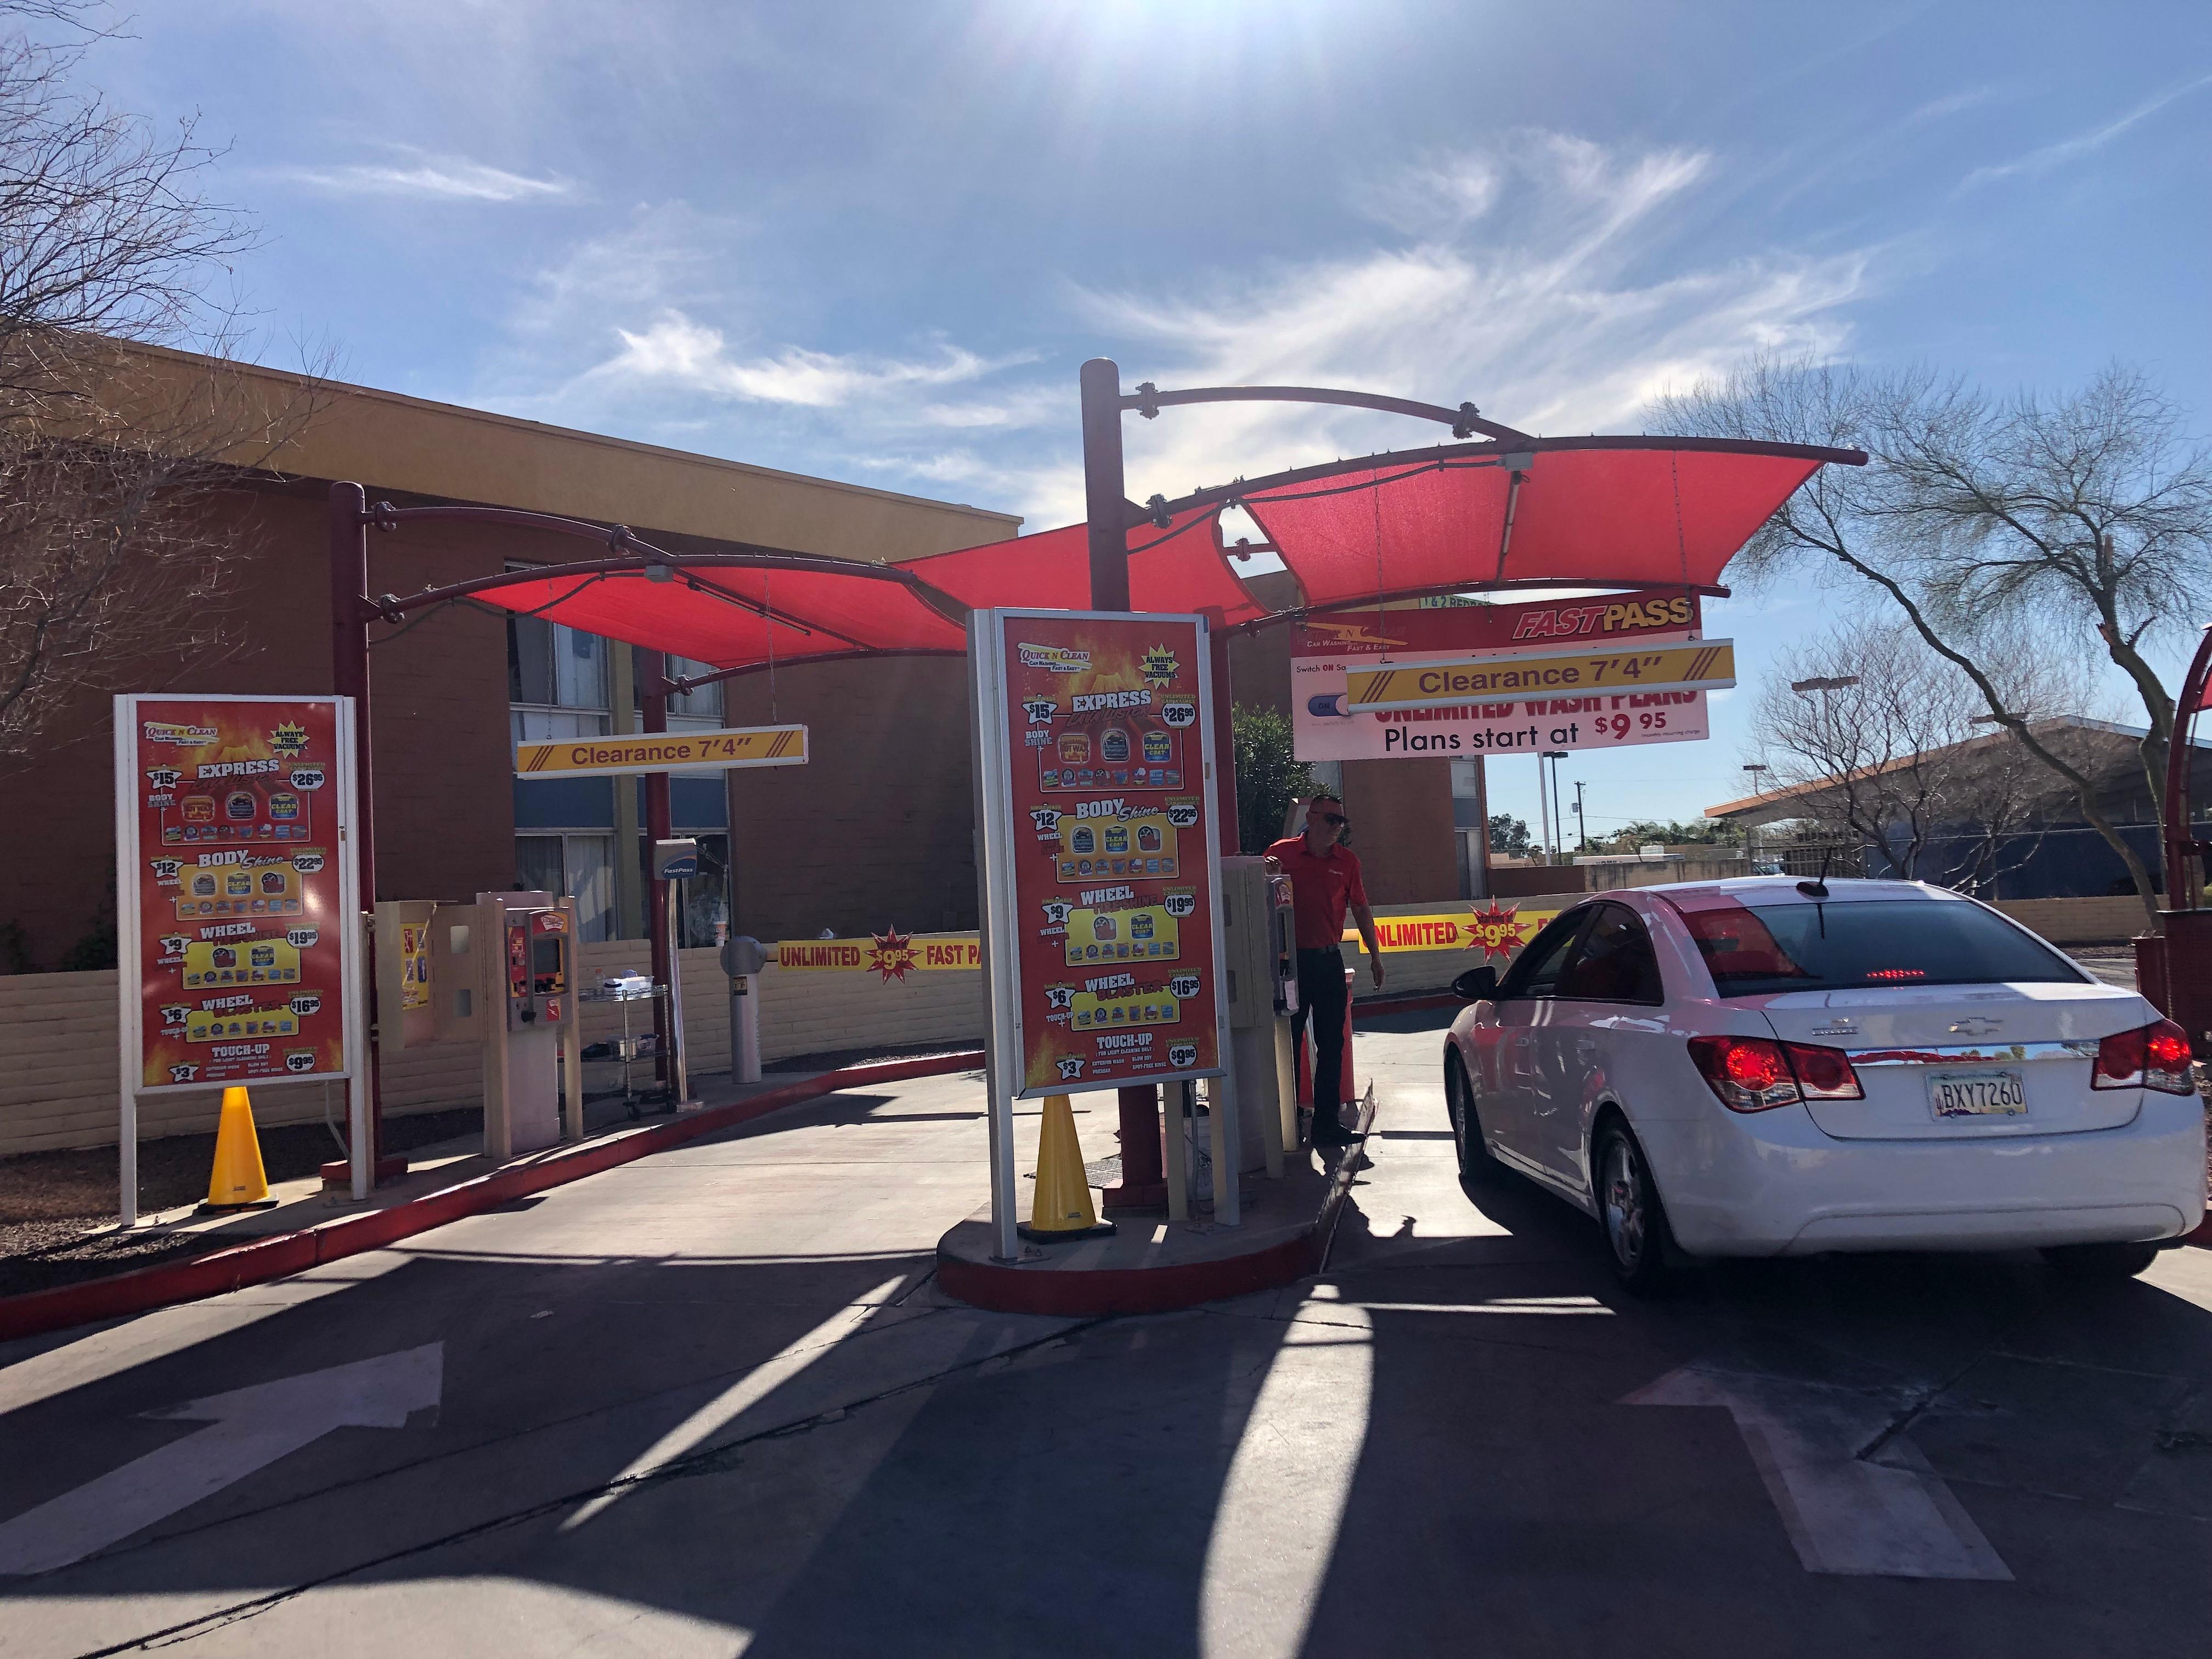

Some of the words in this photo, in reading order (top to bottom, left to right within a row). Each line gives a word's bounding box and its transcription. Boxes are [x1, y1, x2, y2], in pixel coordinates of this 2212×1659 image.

[1022, 650, 1050, 661] QUICK
[1060, 650, 1088, 660] CLEAN
[1296, 664, 1320, 673] Switch
[1419, 667, 1580, 693] Clearance
[1072, 690, 1152, 712] EXPRESS
[1029, 703, 1050, 719] $15
[148, 727, 176, 737] QUICK
[187, 727, 216, 736] CLEAN
[1025, 730, 1049, 739] BODY
[1385, 726, 1461, 752] Plans
[1472, 725, 1538, 748] start
[1550, 723, 1578, 744] at
[1024, 737, 1053, 747] SHINE
[571, 746, 691, 765] Clearance
[198, 759, 280, 779] EXPRESS
[153, 772, 174, 785] $15
[1076, 798, 1125, 819] BODY
[1118, 805, 1159, 822] Shine
[1036, 812, 1054, 826] $12
[1037, 832, 1063, 841] WHEEL
[156, 862, 176, 874] $12
[199, 850, 249, 868] BODY
[240, 856, 284, 870] Shine
[1080, 885, 1135, 906] WHEEL
[1121, 895, 1158, 911] SHINE
[1050, 905, 1064, 919] $9
[200, 922, 256, 939] WHEEL
[1040, 926, 1065, 936] WHEEL
[1363, 922, 1457, 947] NLIMITED
[168, 939, 182, 951] $9
[780, 946, 860, 967] UNLIMITED
[927, 945, 964, 965] FAST
[1085, 973, 1135, 992] WHEEL
[1053, 990, 1066, 1004] $6
[1096, 980, 1164, 1002] BLASTER
[201, 994, 253, 1011] WHEEL
[168, 1008, 182, 1020] $6
[1046, 1012, 1074, 1023] TOUCH-UP
[1096, 1032, 1153, 1049] TOUCH-UP
[212, 1043, 270, 1058] TOUCH-UP
[176, 1066, 189, 1077] $3
[1063, 1061, 1077, 1074] $3
[1941, 1082, 2023, 1108] BXY7260
